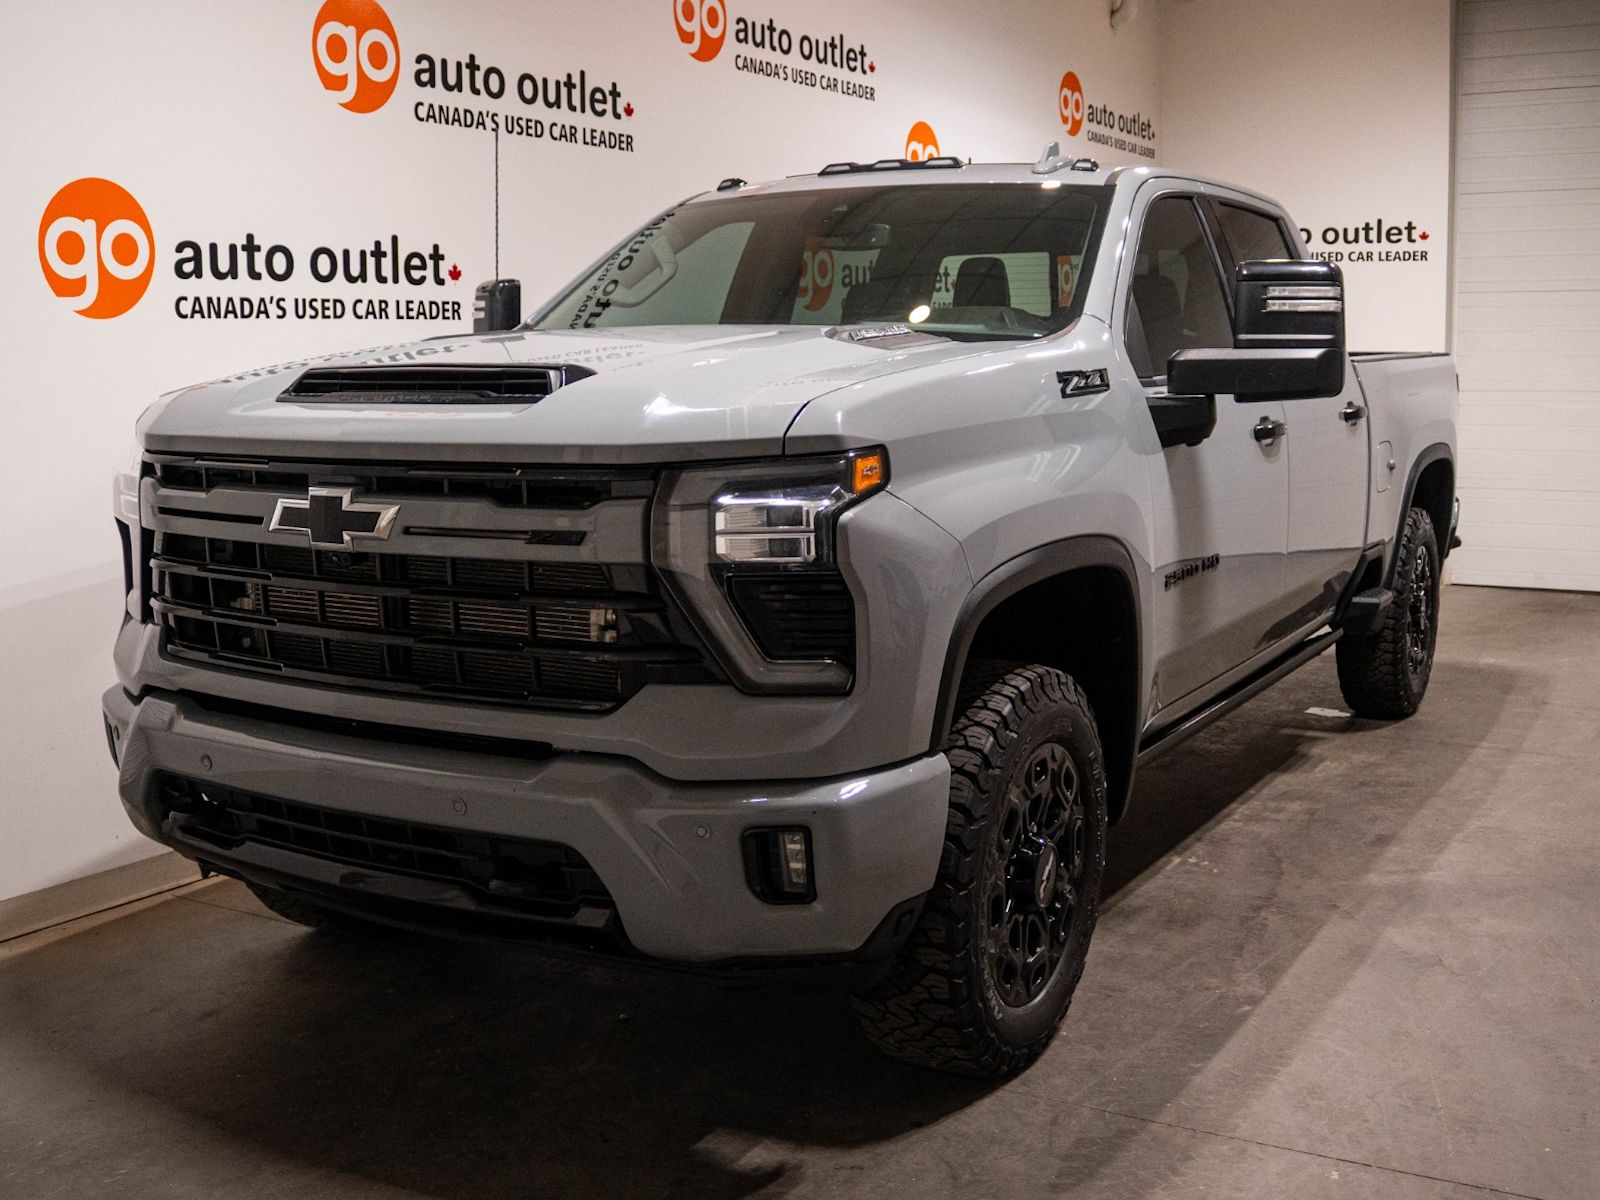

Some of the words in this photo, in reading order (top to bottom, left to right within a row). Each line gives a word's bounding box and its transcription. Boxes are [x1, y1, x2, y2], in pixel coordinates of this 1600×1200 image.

[674, 0, 727, 55] go
[734, 16, 793, 56] auto
[798, 33, 868, 76] outlet
[315, 20, 397, 104] go
[413, 52, 506, 100] auto
[516, 69, 622, 121] outlet
[734, 53, 789, 82] CANADA'S
[791, 67, 817, 88] USED
[819, 74, 839, 93] CAR
[841, 79, 876, 102] LEADER
[413, 101, 500, 132] CANADA'S
[504, 114, 545, 139] USED
[548, 121, 579, 145] CAR
[582, 126, 634, 153] LEADER
[1060, 87, 1083, 132] go
[1087, 103, 1116, 130] auto
[1118, 112, 1152, 142] outlet
[1087, 130, 1114, 148] CANADA'S
[1114, 137, 1127, 152] USED
[1128, 142, 1137, 154] CAR
[1138, 145, 1155, 160] LEADER
[1311, 250, 1345, 262] USED
[1347, 250, 1374, 262] CAR
[1378, 250, 1429, 262] LEADER
[1321, 218, 1417, 245] outlet
[44, 215, 151, 312] go
[173, 232, 295, 282] auto
[309, 234, 446, 287] outlet
[174, 295, 287, 320] CANADA'S
[294, 297, 346, 320] USED
[352, 298, 390, 320] CAR
[395, 299, 462, 321] LEADER
[1056, 368, 1110, 399] Z71
